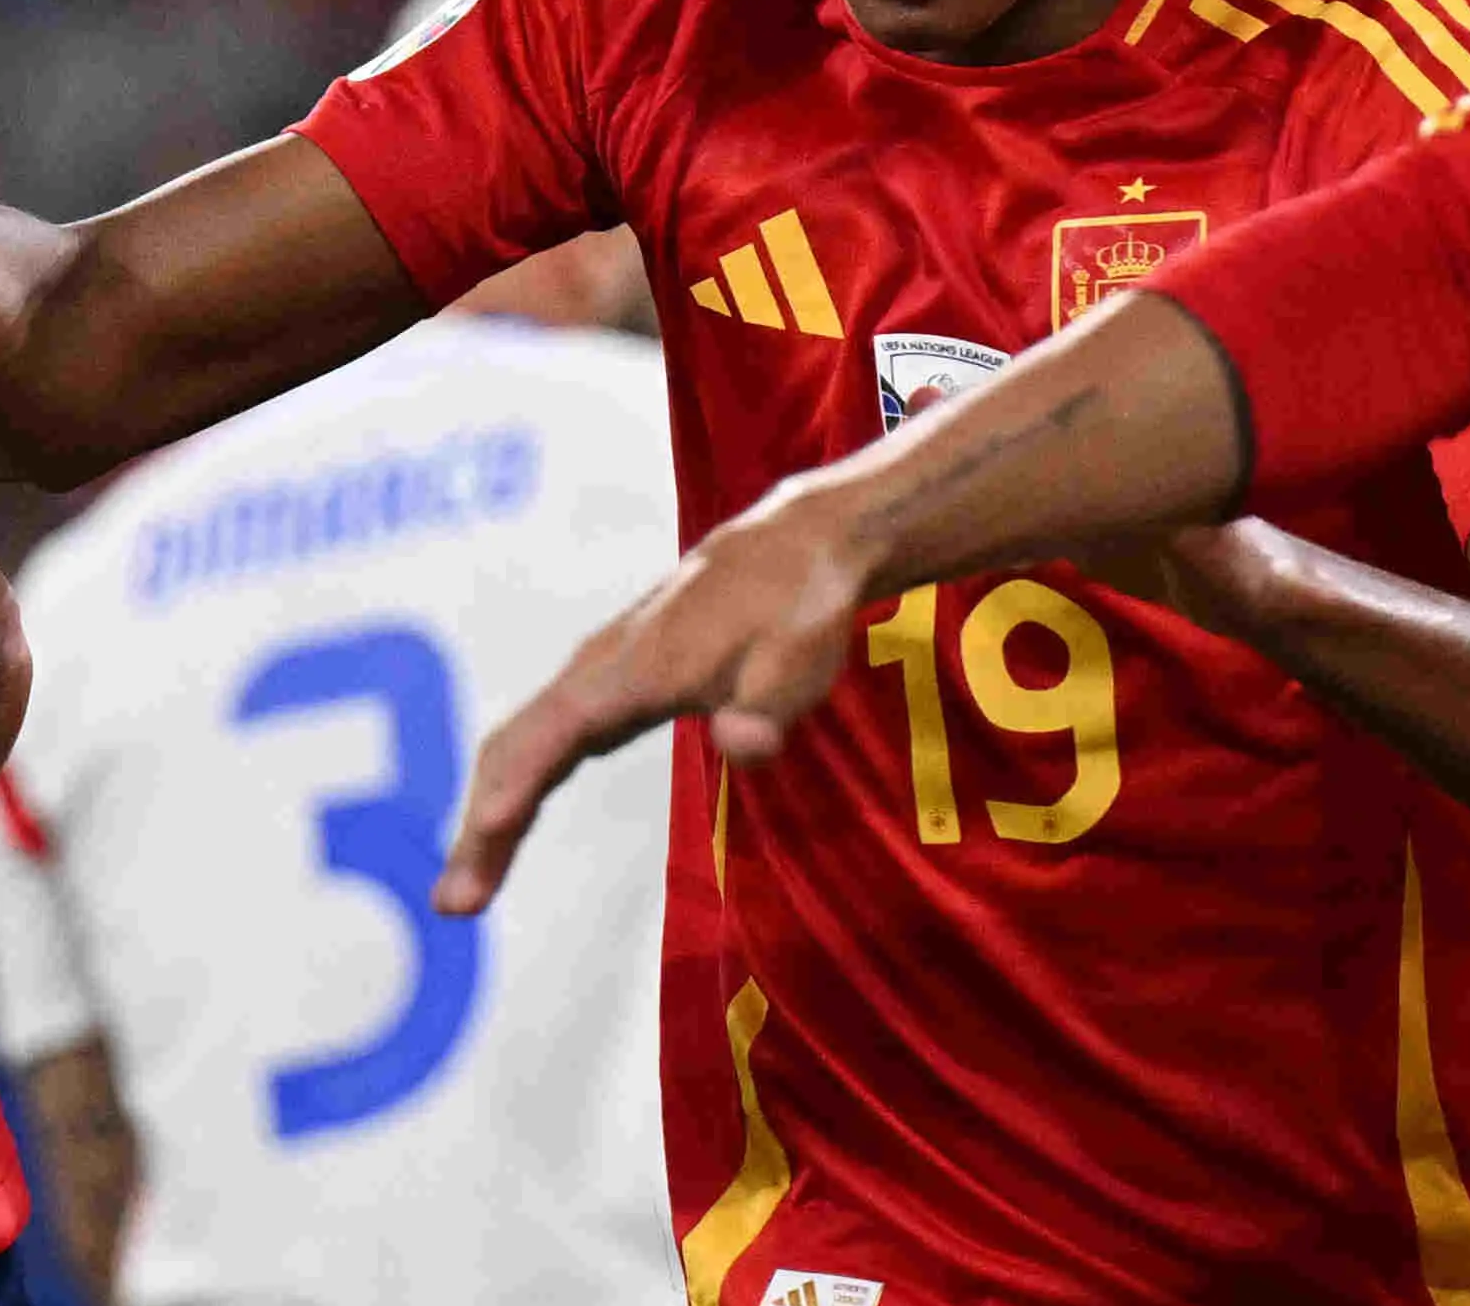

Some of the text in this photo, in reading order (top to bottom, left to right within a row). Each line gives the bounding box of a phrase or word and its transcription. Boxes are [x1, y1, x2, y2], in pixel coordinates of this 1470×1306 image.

[908, 342, 957, 356] NATIONS
[868, 579, 1122, 846] 19
[228, 619, 488, 1143] 3
